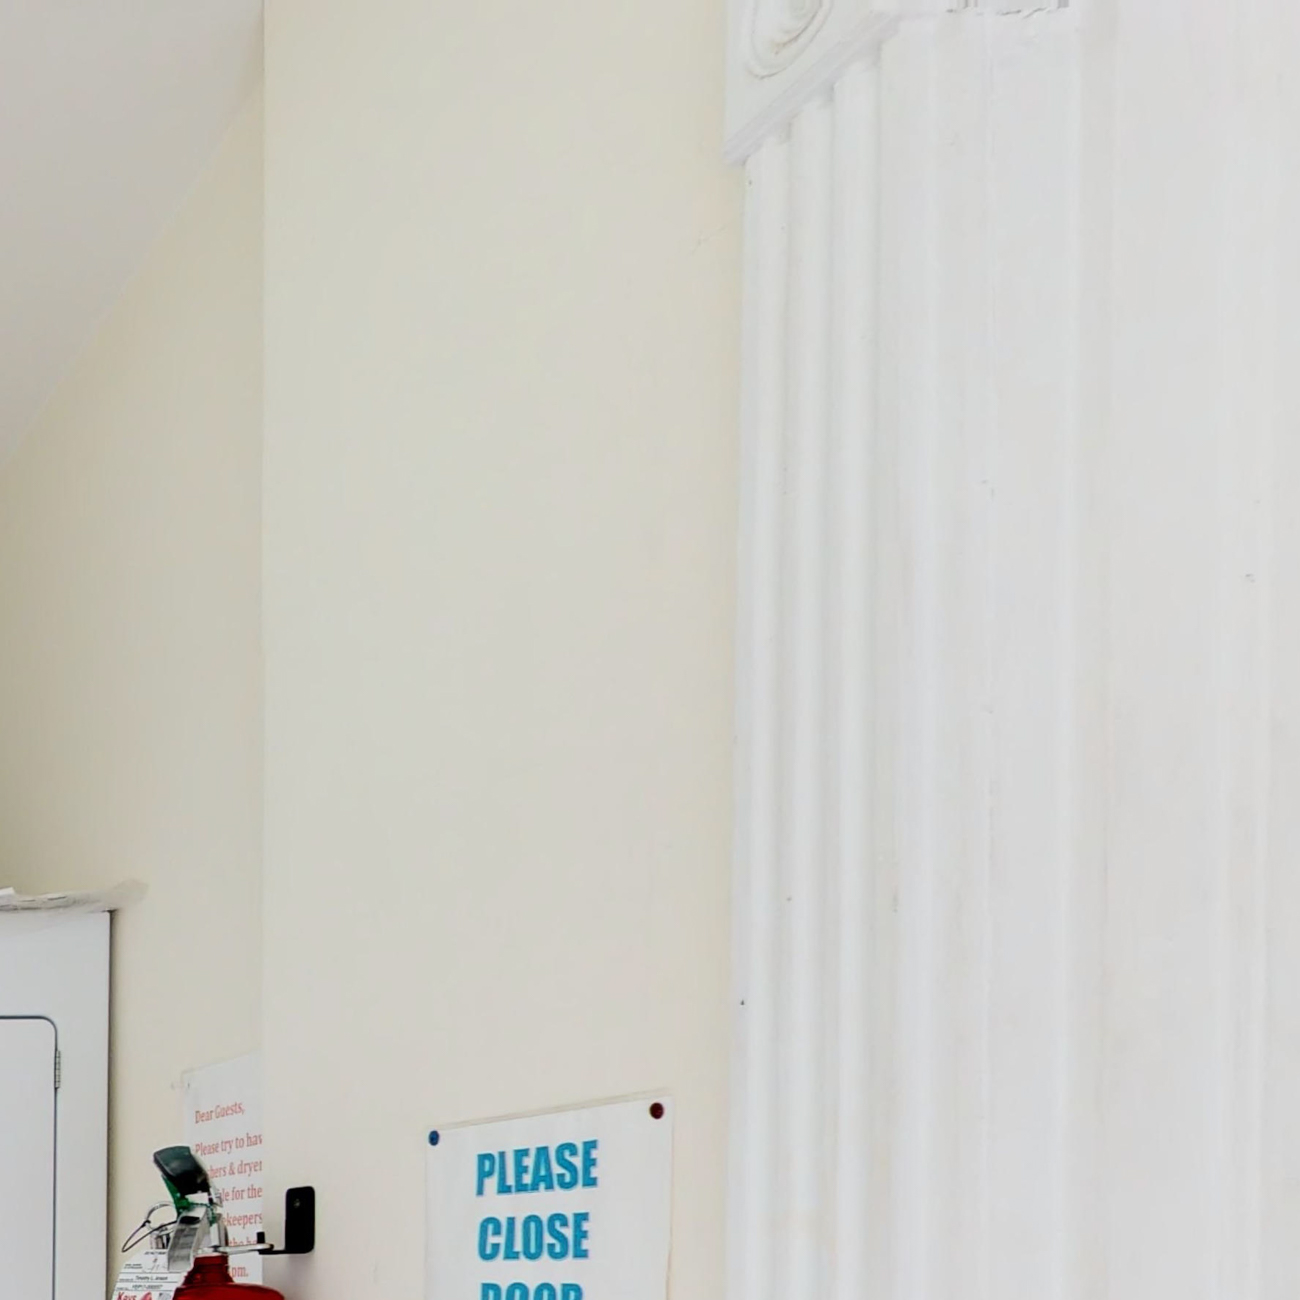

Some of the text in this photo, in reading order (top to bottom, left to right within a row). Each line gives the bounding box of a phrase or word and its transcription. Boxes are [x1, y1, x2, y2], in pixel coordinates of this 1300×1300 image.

[195, 1101, 245, 1124] Dear Guests,
[195, 1132, 262, 1156] Please try to hav
[207, 1164, 227, 1179] hers
[228, 1163, 236, 1176] &
[475, 1138, 598, 1197] PLEASE
[231, 1186, 245, 1200] for
[246, 1184, 262, 1198] the
[478, 1211, 590, 1262] CLOSE
[231, 1265, 248, 1278] pm.
